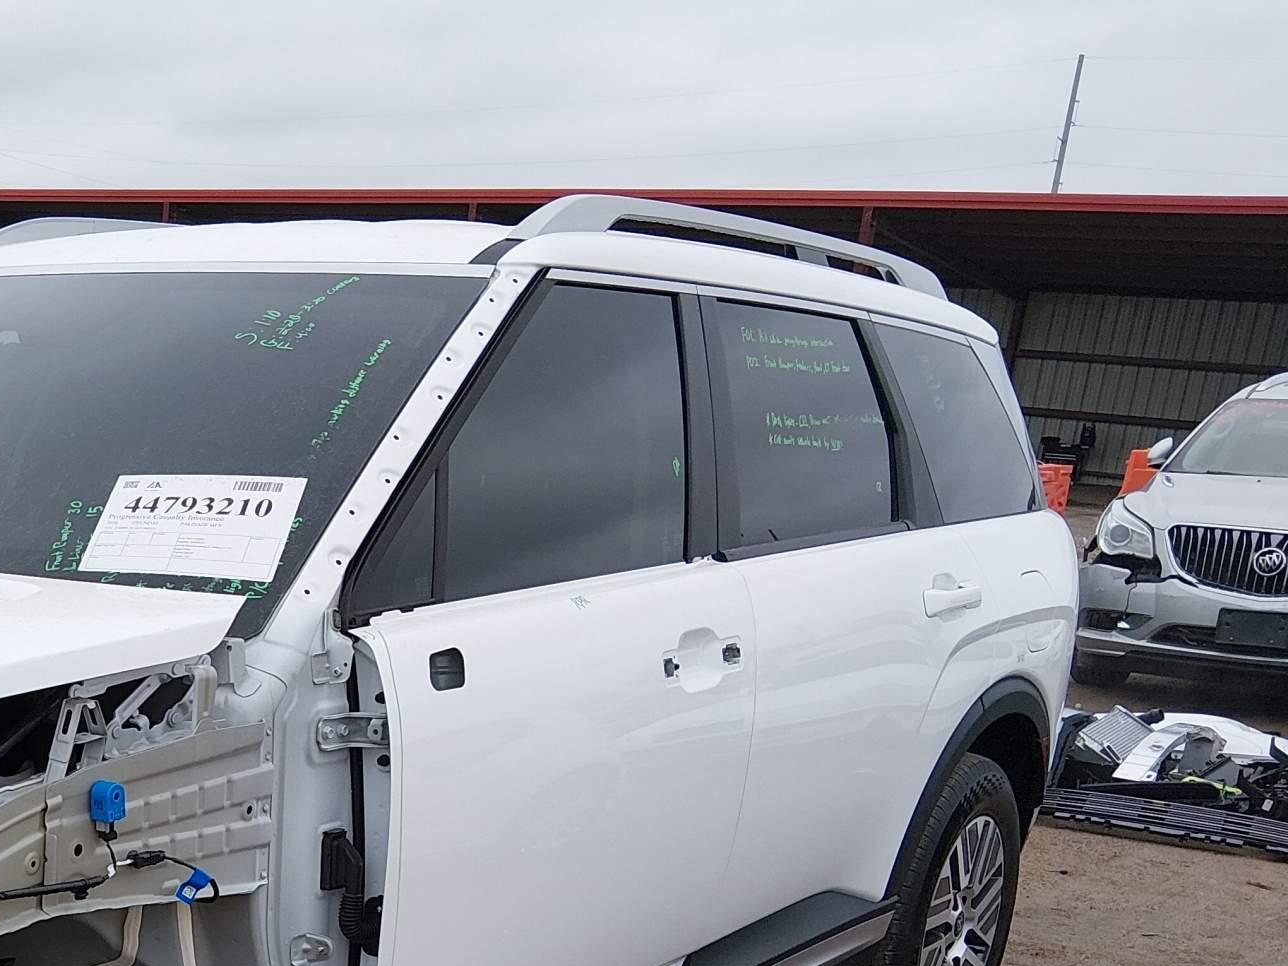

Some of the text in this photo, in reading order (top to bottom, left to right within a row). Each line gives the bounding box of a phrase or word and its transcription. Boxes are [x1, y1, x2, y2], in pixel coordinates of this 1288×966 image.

[124, 495, 273, 518] 44793210
[153, 513, 185, 521] Casualty
[187, 514, 226, 522] Insurance
